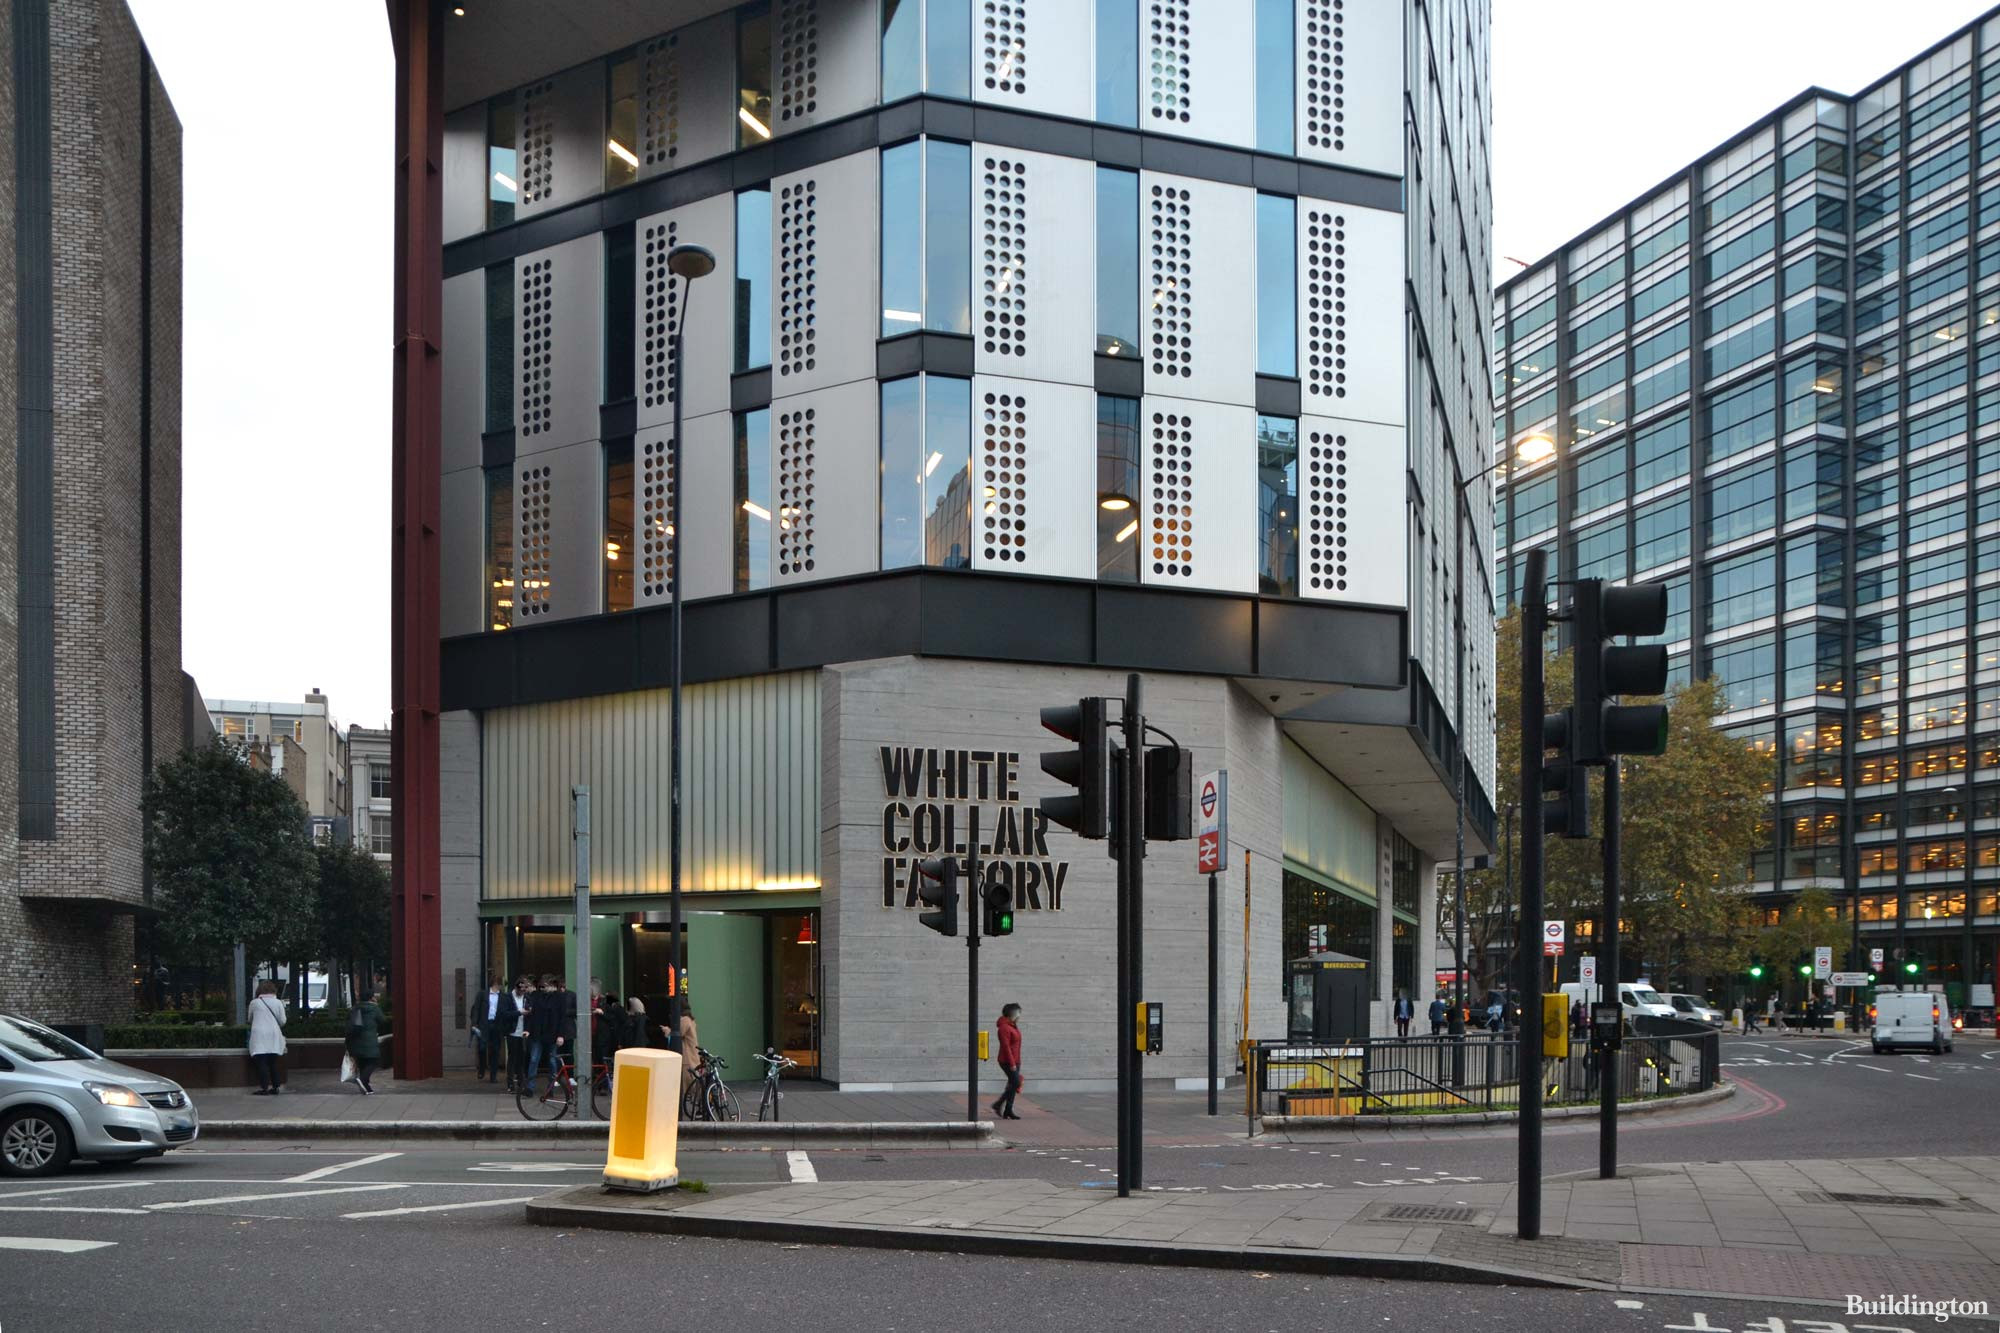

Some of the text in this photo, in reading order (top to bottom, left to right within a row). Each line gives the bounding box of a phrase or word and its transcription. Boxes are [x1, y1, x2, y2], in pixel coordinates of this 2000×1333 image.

[880, 746, 1019, 800] WHITE
[883, 802, 1049, 856] COLLAR
[1220, 1176, 1483, 1191] LOOK LEFT
